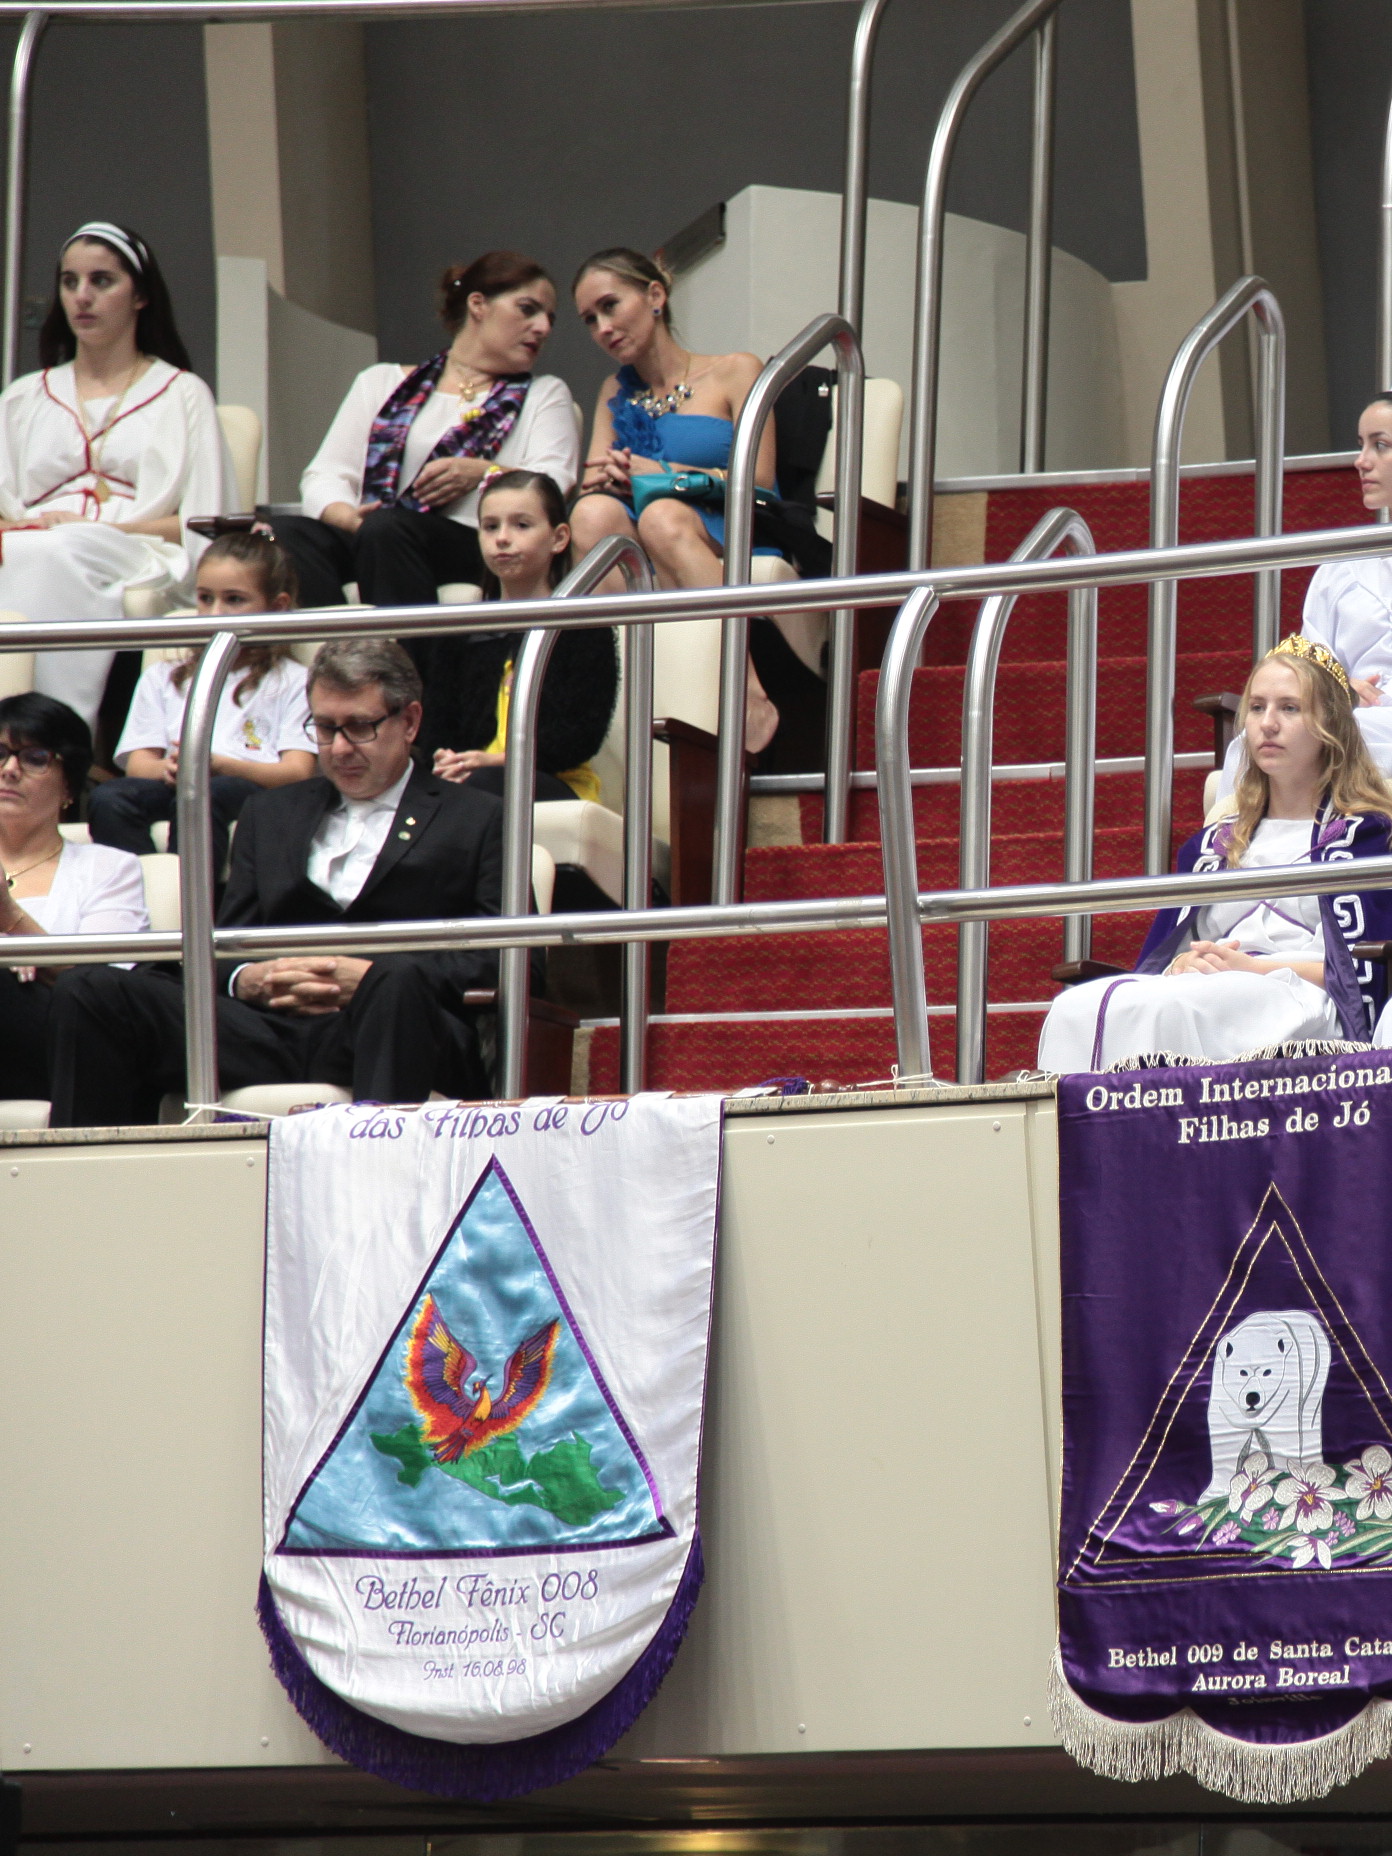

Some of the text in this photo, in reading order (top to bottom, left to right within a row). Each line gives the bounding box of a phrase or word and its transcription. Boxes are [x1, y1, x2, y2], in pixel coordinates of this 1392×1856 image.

[1085, 1083, 1184, 1112] Ordem
[349, 1108, 406, 1139] das
[1178, 1101, 1371, 1144] Filhas de Jó
[355, 1568, 600, 1612] Bethel Fênix 008
[388, 1618, 509, 1650] Florianópolis
[530, 1611, 566, 1640] SC
[1108, 1645, 1178, 1669] Bethel
[1187, 1643, 1224, 1664] 009
[1233, 1641, 1259, 1661] de
[1269, 1638, 1333, 1660] Santa
[1191, 1665, 1350, 1692] Aurora Boreal
